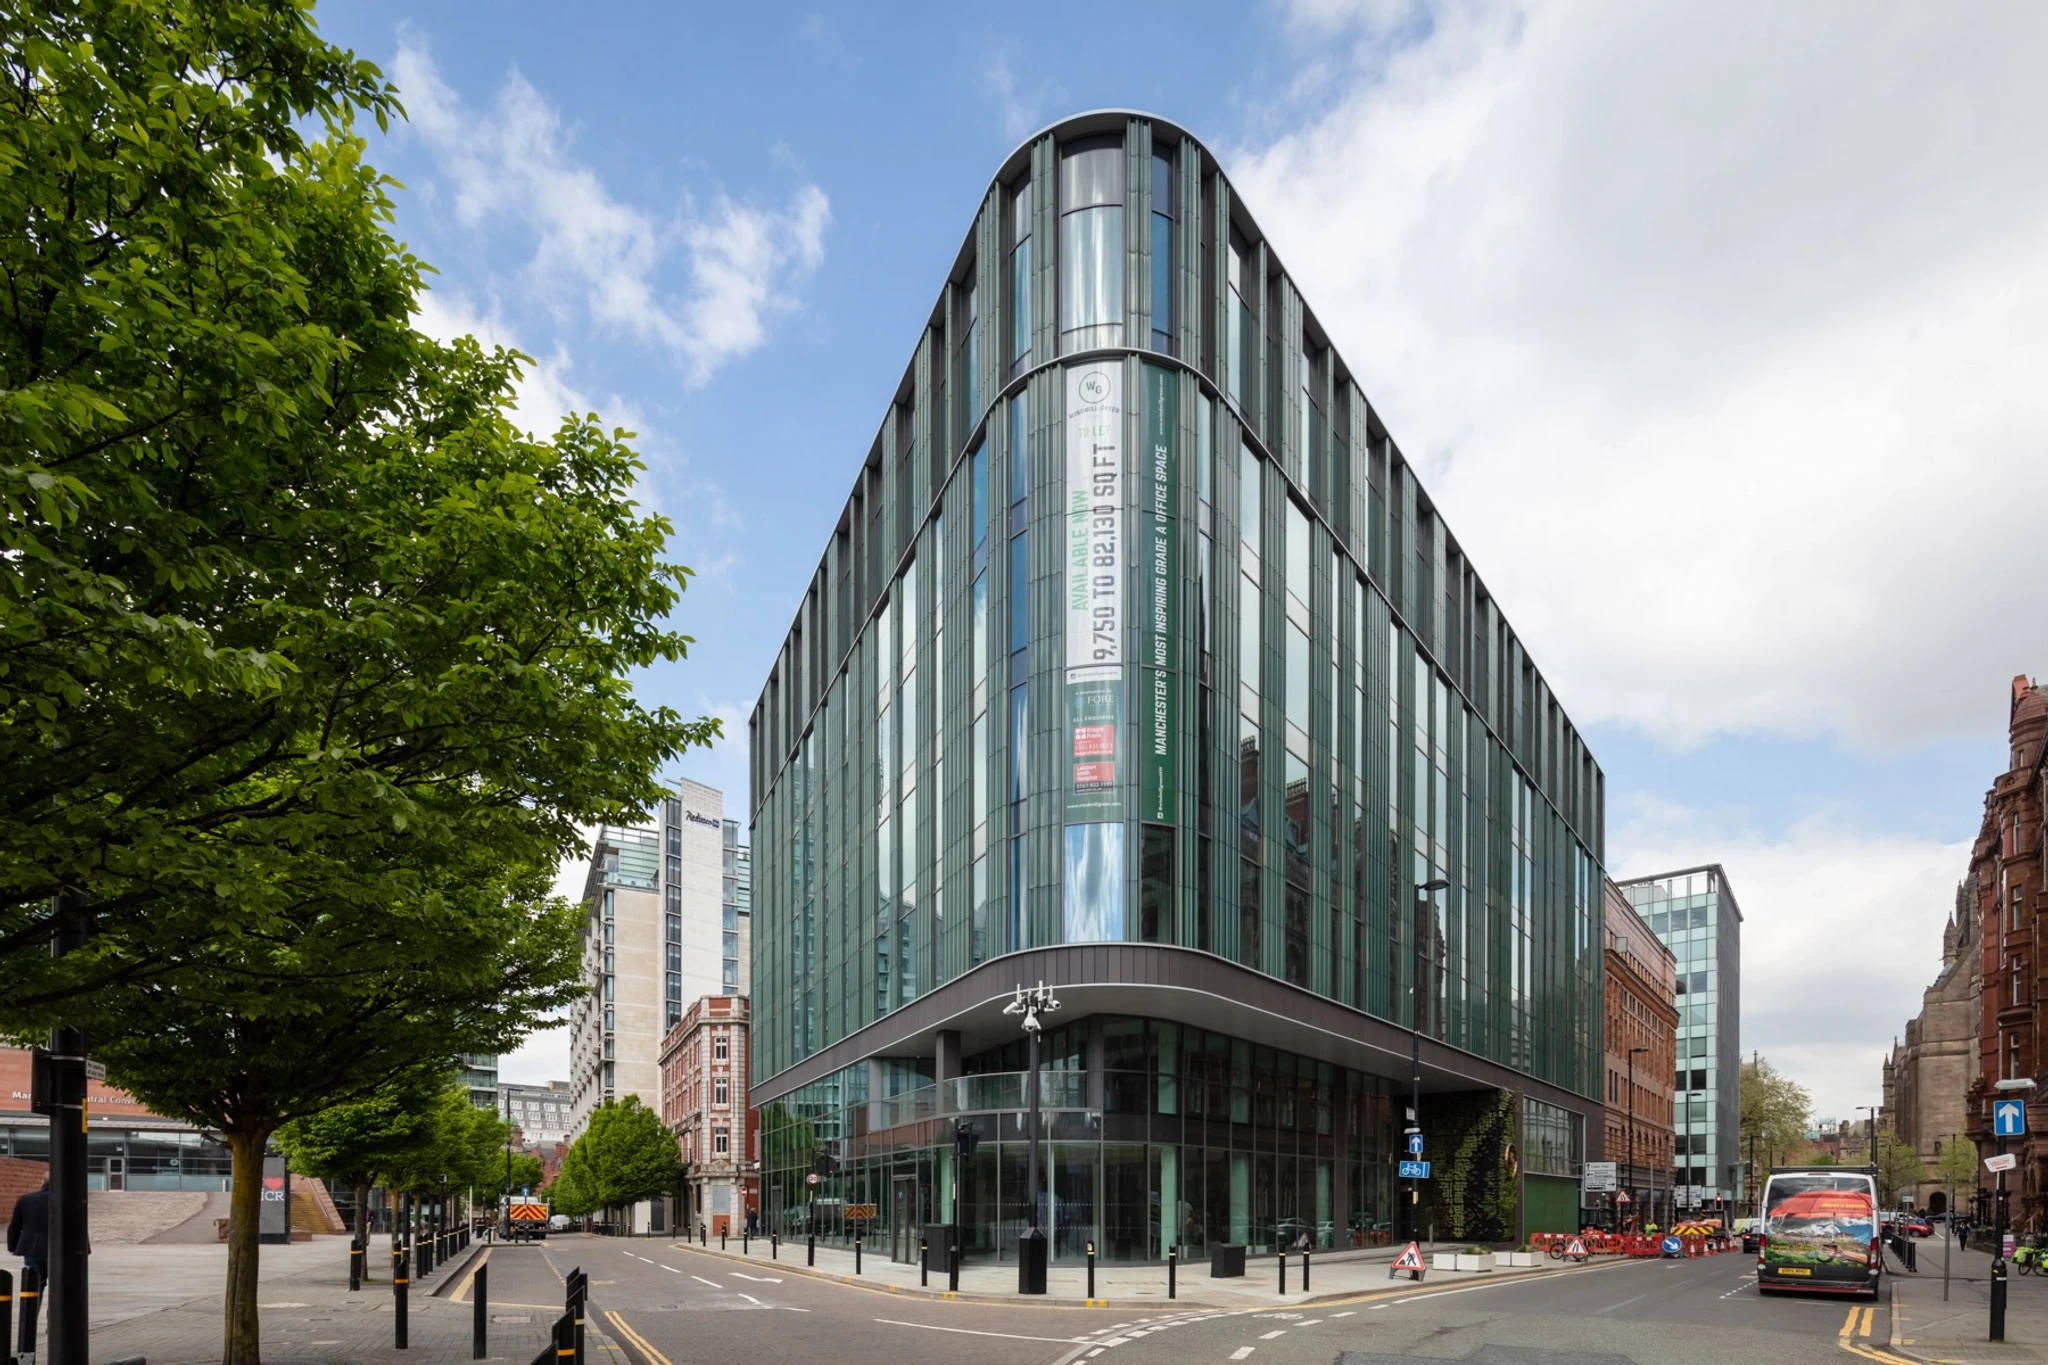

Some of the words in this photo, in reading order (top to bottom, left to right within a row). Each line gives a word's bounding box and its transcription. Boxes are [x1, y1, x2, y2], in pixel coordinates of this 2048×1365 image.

[1069, 405, 1098, 419] WINDMILL
[1100, 405, 1121, 414] GREEN
[1078, 427, 1089, 438] TO
[1092, 425, 1112, 437] LET
[1155, 444, 1167, 482] SPACE
[1071, 489, 1089, 524] NOW
[1155, 483, 1167, 523] OFFICE
[1093, 505, 1117, 567] 82,130
[1155, 526, 1167, 535] A
[1071, 527, 1089, 611] AVAILABLE
[1155, 537, 1167, 576] GRADE
[1093, 575, 1115, 600] TO
[1155, 577, 1167, 633] INSPIRING
[1093, 606, 1117, 661] 9,750
[1155, 633, 1167, 667] MOST
[1088, 695, 1114, 704] FORE
[1155, 670, 1167, 755] MANCHESTER'S
